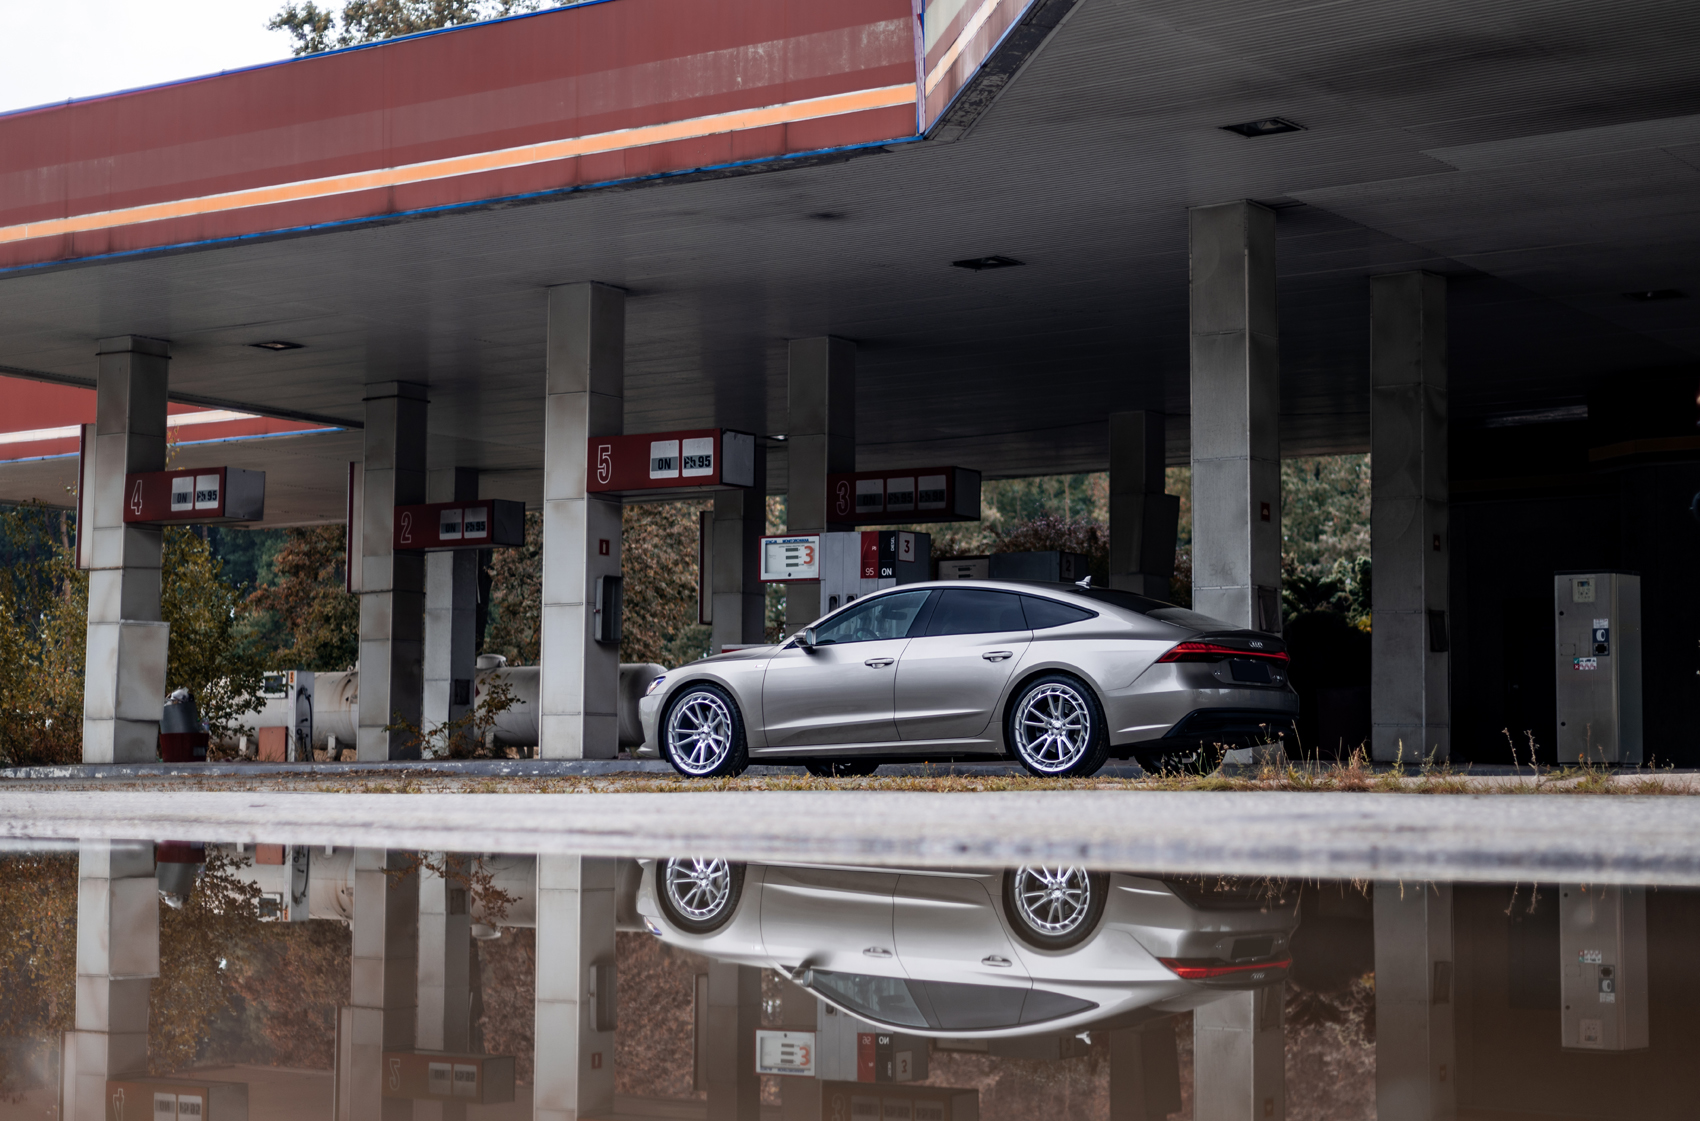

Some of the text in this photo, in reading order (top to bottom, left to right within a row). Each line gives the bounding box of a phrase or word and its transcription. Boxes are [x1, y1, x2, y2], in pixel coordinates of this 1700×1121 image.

[597, 444, 612, 484] 5
[658, 458, 671, 470] ON
[130, 479, 143, 515] 4
[177, 493, 187, 503] ON
[836, 480, 850, 516] 3
[863, 495, 875, 506] ON
[400, 511, 412, 544] 2
[445, 523, 456, 533] ON
[904, 539, 910, 553] 3
[803, 545, 814, 565] 3
[865, 568, 874, 576] 95
[881, 568, 892, 576] ON
[1065, 560, 1071, 572] 2
